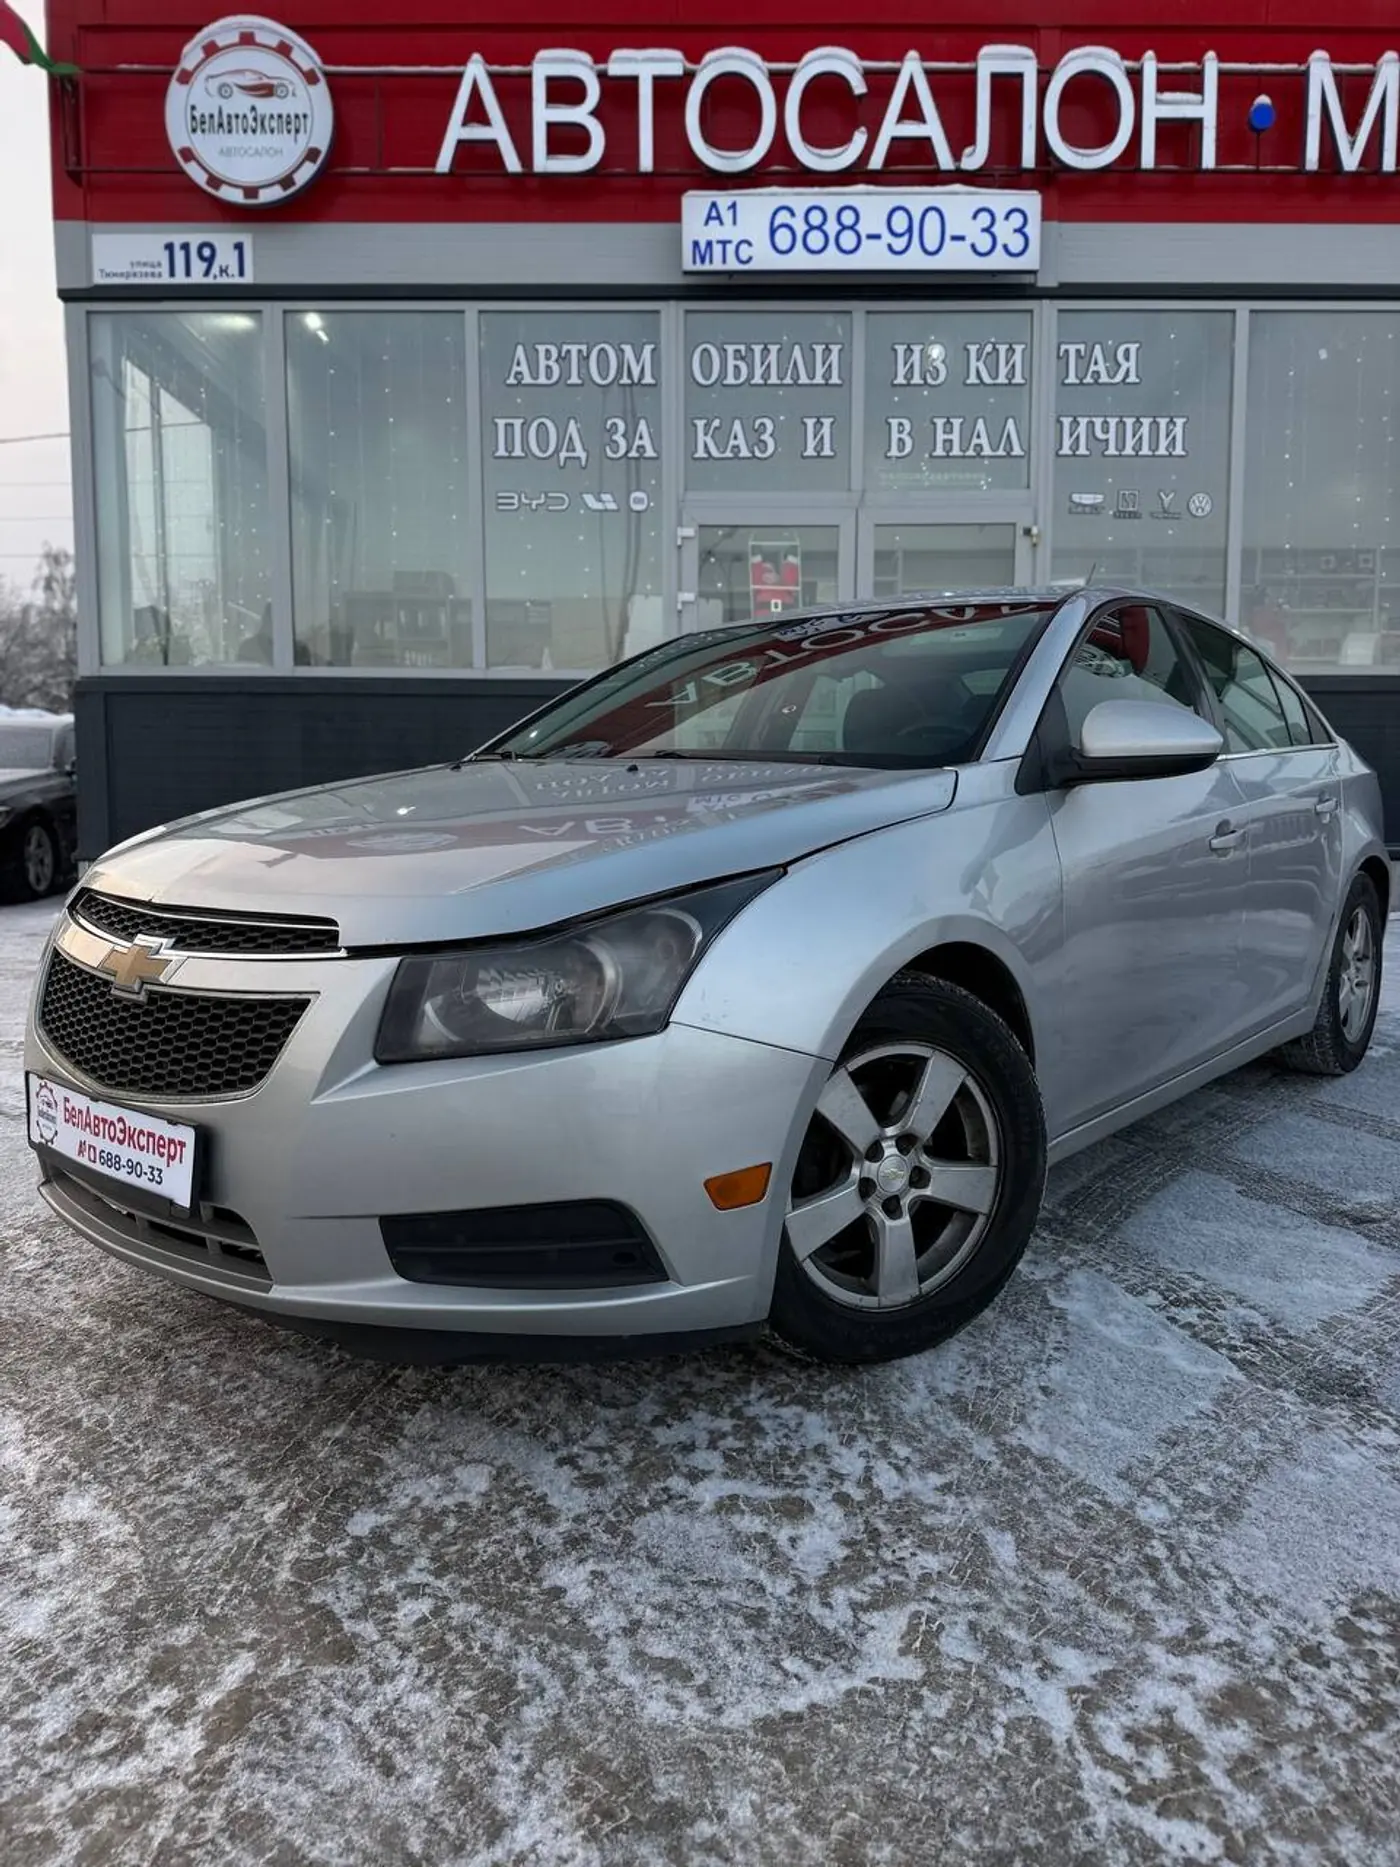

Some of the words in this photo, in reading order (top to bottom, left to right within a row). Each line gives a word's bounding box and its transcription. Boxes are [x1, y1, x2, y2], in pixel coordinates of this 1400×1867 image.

[189, 104, 309, 145] БелАвтоЭксперт
[436, 46, 1219, 173] АВТОСАЛОН
[218, 145, 284, 158] АВТОСАЛОН
[703, 200, 739, 227] А1
[767, 204, 1032, 258] 688-90-33
[690, 239, 754, 266] МТС
[505, 343, 656, 386] АВТОМ
[691, 343, 844, 386] ОБИЛИ
[892, 343, 948, 386] ИЗ
[965, 343, 1027, 386] КИ
[1059, 343, 1142, 384] ТАЯ
[493, 417, 588, 468] ПОД
[604, 417, 659, 459] ЗА
[692, 417, 776, 459] КАЗ
[802, 417, 836, 457] И
[886, 417, 914, 458] В
[930, 417, 1026, 458] НАЛ
[63, 1096, 187, 1168] БелАвтоЭксперт
[99, 1149, 164, 1186] 688-90-33
